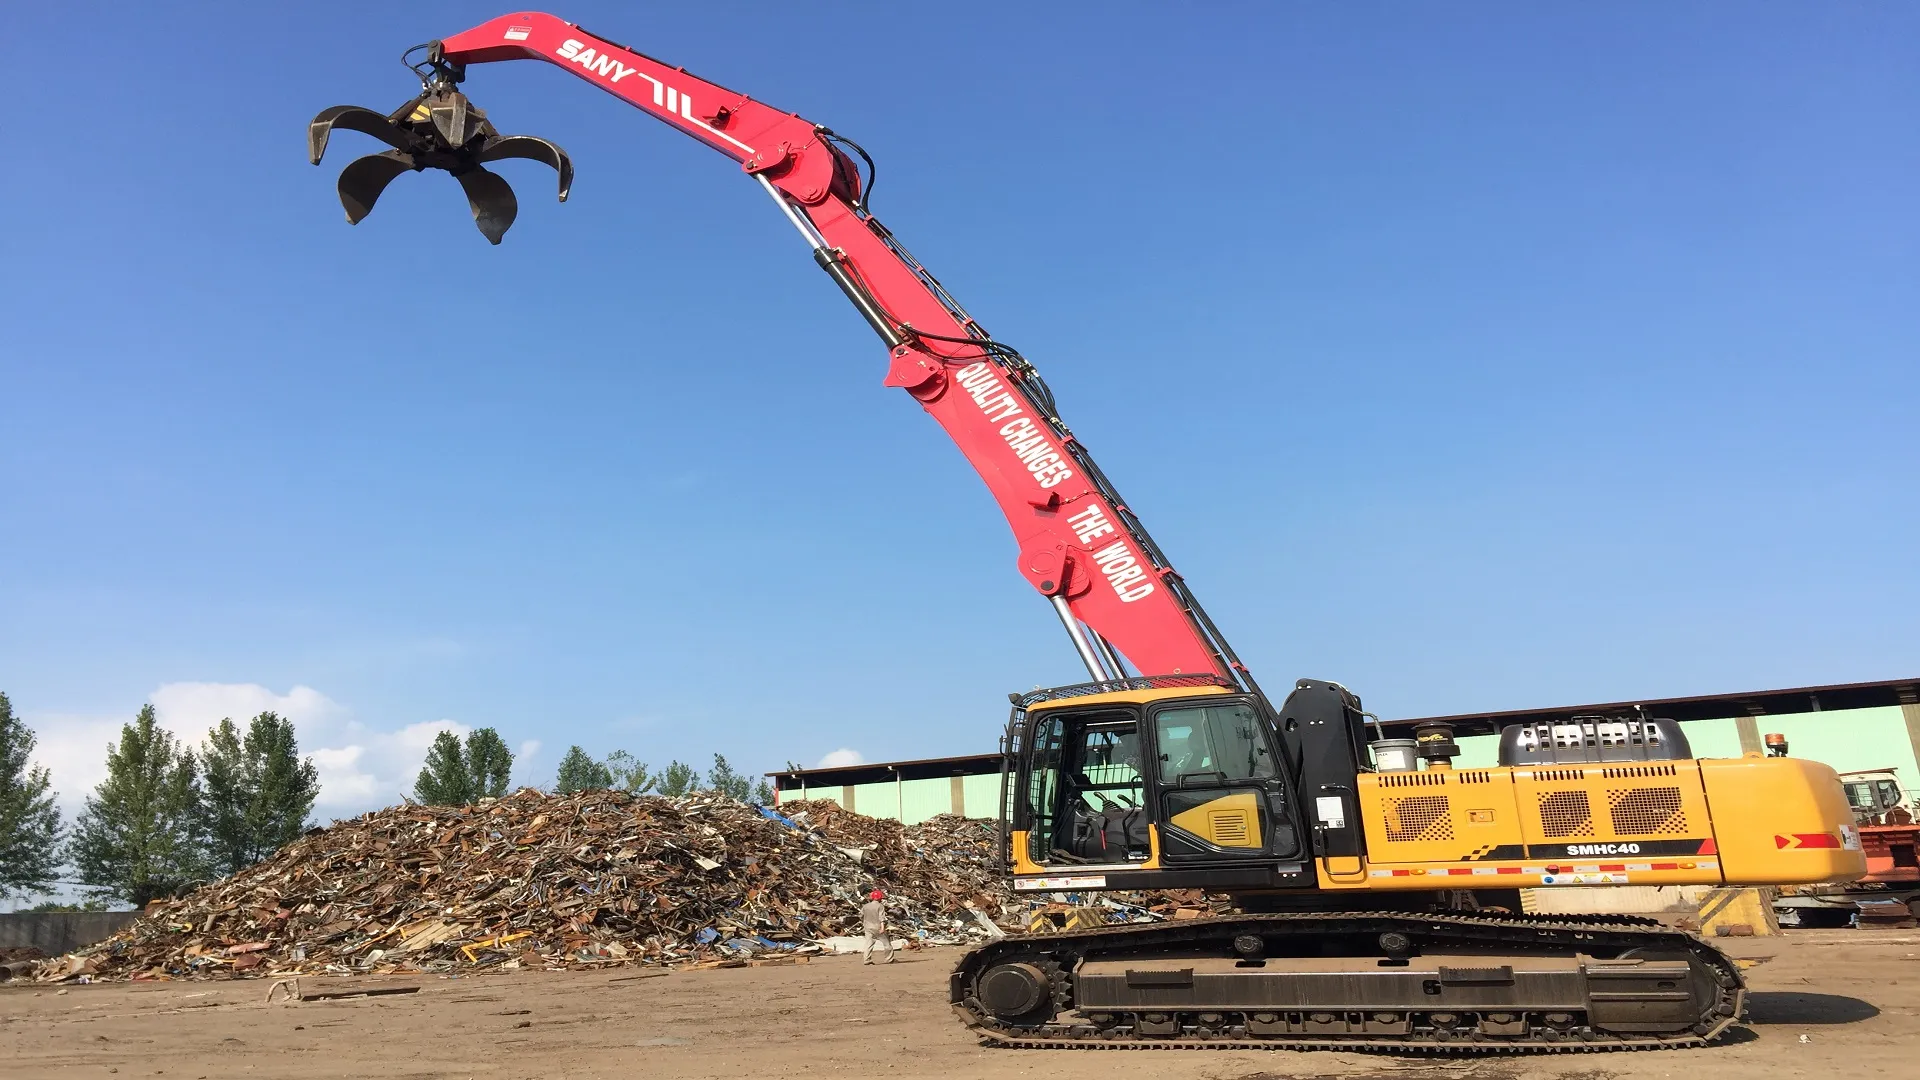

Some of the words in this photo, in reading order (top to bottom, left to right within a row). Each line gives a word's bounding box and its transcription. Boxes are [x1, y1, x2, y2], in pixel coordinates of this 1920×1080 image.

[555, 38, 637, 83] SANY
[955, 361, 1024, 424] QUALITY
[999, 417, 1073, 489] CHANGES
[1066, 503, 1115, 545] THE
[1092, 540, 1156, 604] WORLD
[1566, 843, 1640, 856] SMHC40
